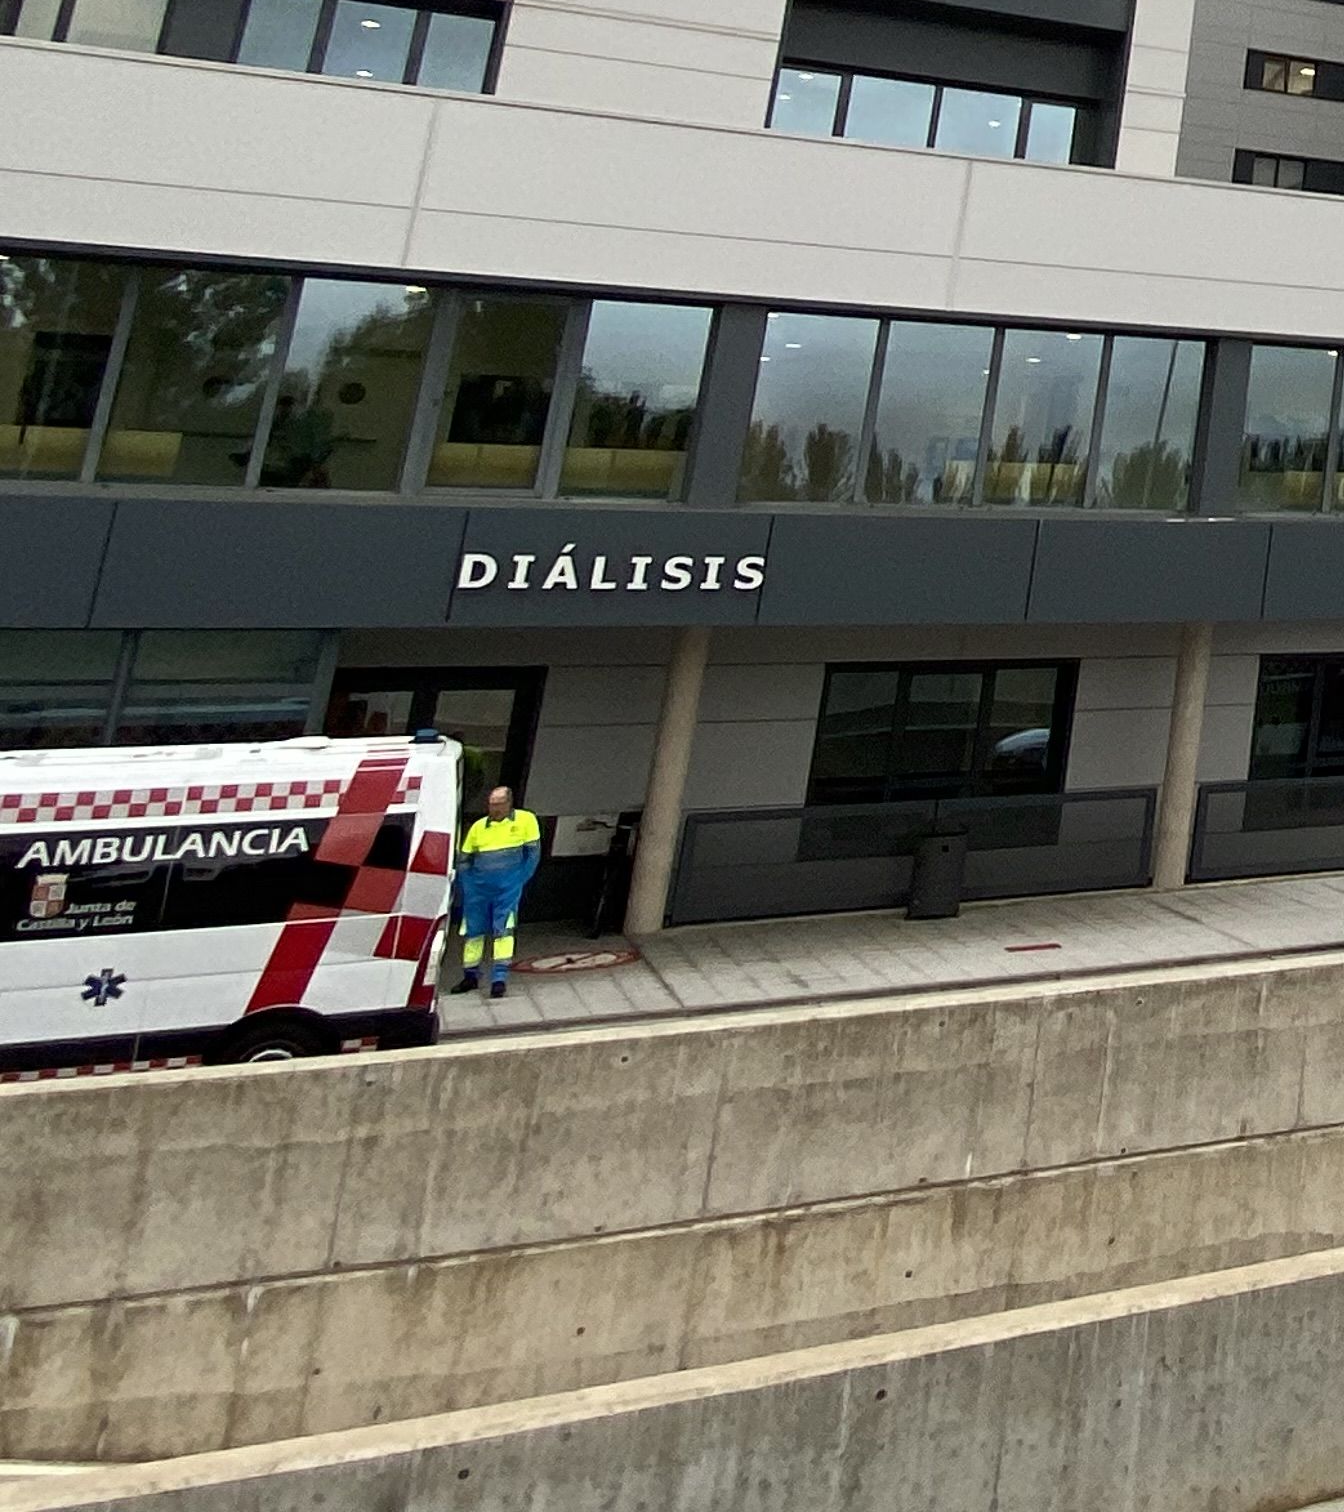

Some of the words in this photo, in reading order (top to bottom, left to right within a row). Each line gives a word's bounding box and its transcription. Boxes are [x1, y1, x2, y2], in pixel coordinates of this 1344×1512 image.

[457, 543, 765, 590] DIÁLISIS
[15, 827, 309, 869] AMBULANCIA
[64, 902, 111, 915] Junta
[114, 899, 137, 912] de
[77, 918, 89, 930] y
